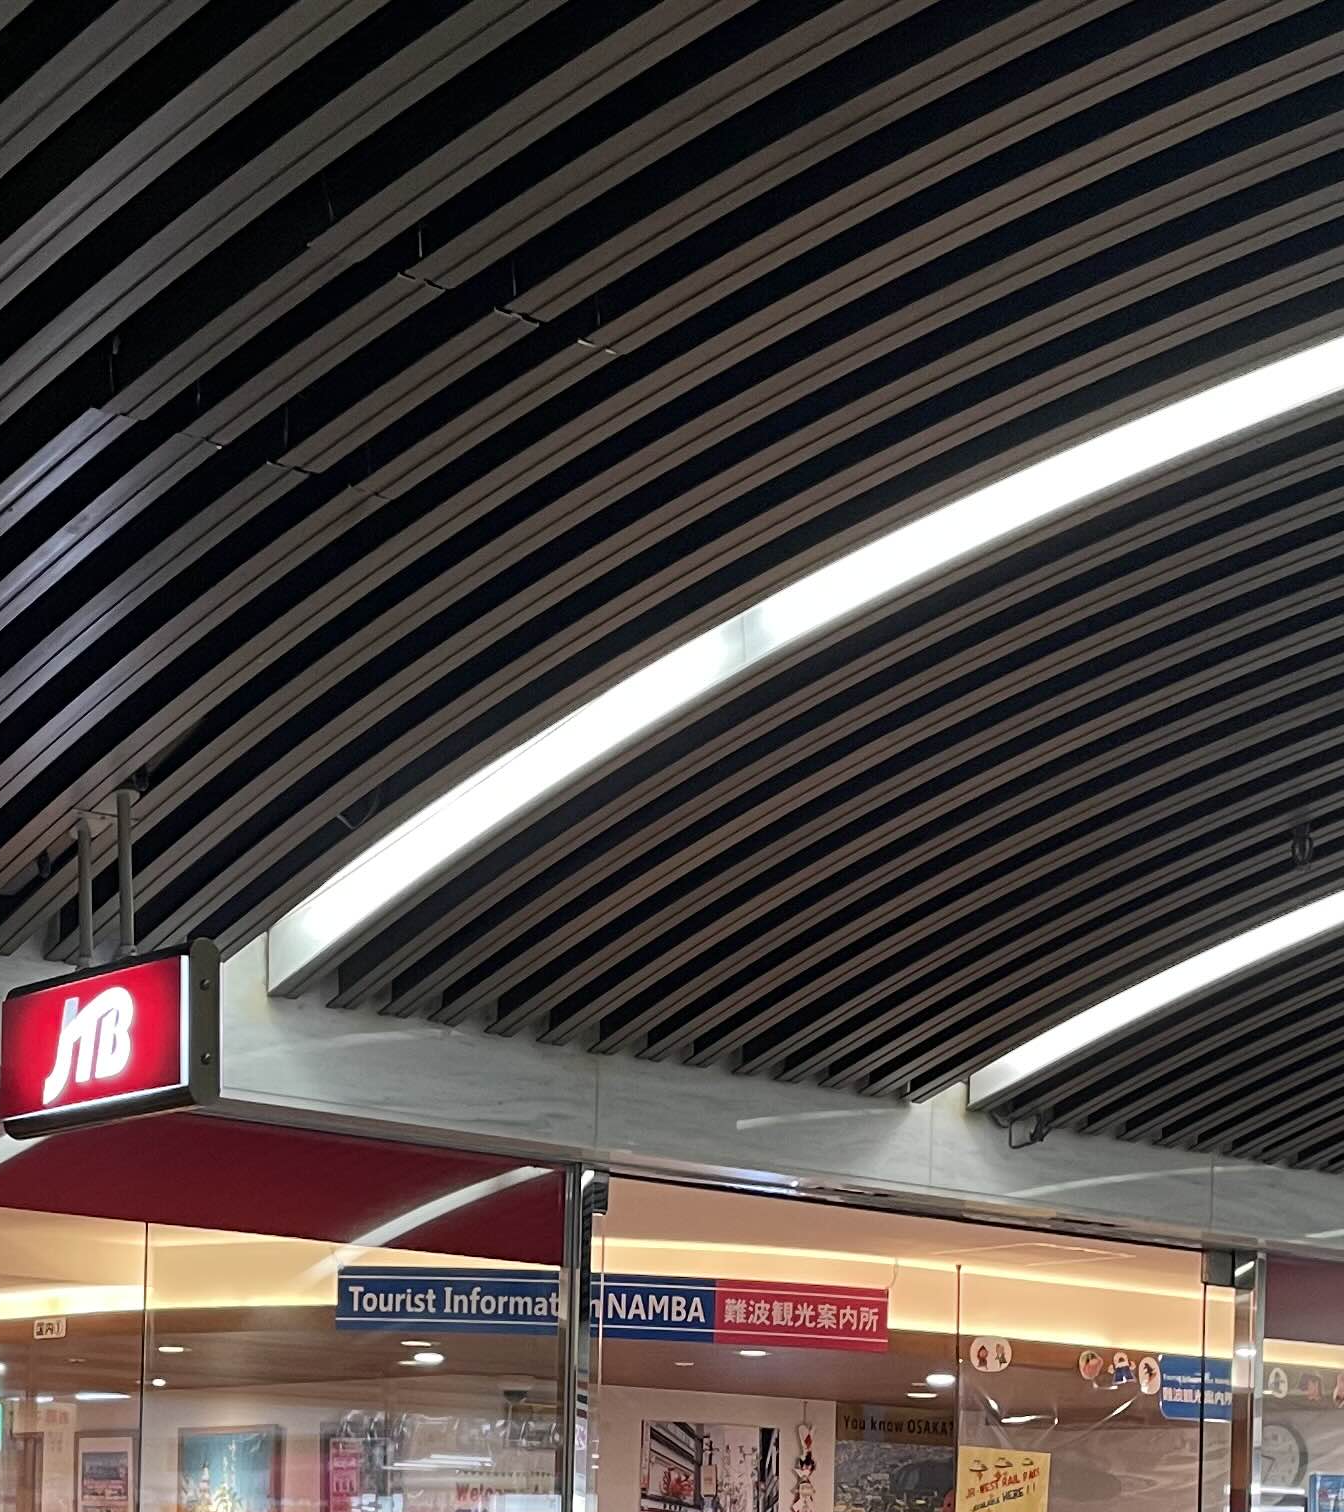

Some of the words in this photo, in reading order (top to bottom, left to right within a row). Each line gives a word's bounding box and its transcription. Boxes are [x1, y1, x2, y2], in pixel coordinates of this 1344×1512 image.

[42, 986, 134, 1103] JTB
[348, 1285, 437, 1313] Tourist
[444, 1287, 601, 1321] Informatn
[607, 1293, 705, 1323] NAMBA
[723, 1298, 879, 1332] 難波観光案内所
[843, 1415, 866, 1430] You
[870, 1416, 903, 1433] know
